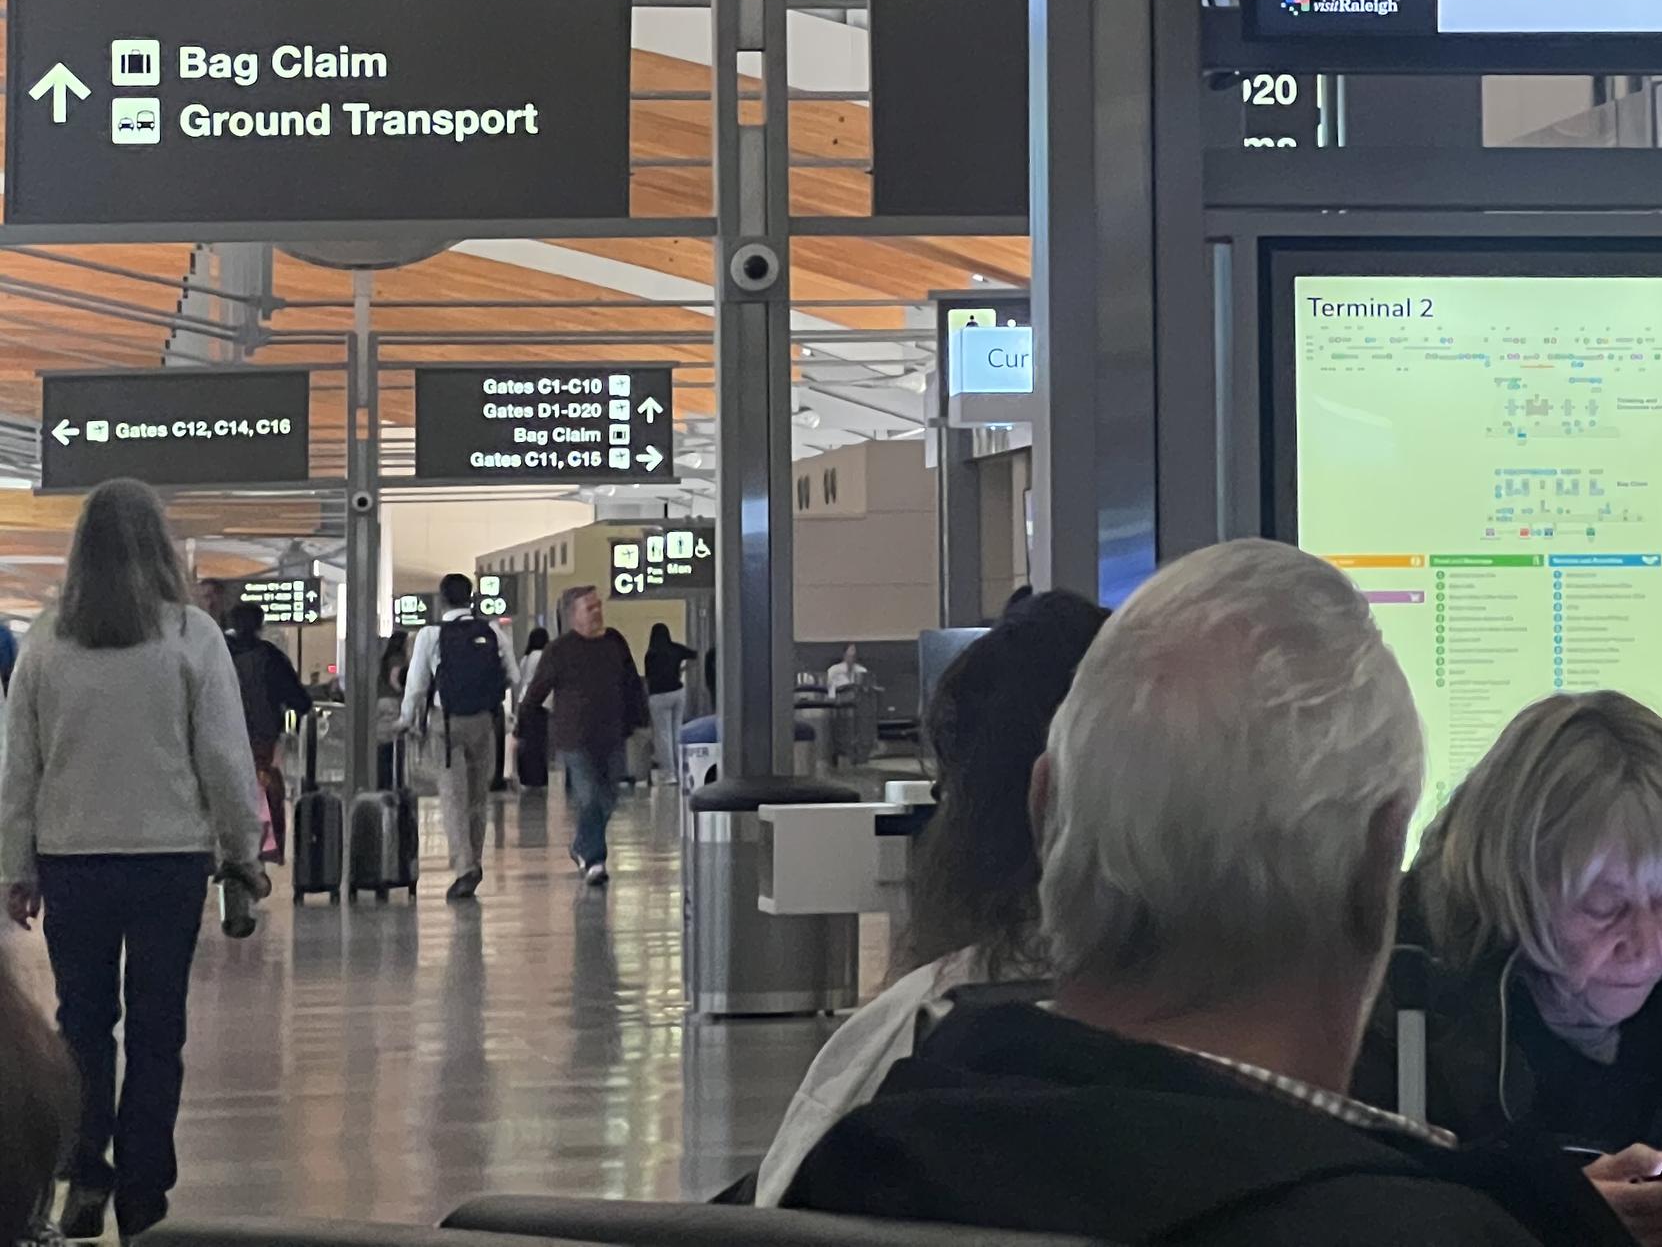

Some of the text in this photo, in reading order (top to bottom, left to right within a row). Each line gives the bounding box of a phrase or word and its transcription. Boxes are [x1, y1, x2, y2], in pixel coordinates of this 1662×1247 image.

[179, 45, 387, 85] Bag Claim
[179, 102, 539, 142] Ground Transport
[1306, 296, 1434, 319] Terminal 2
[988, 348, 1029, 368] Cur
[482, 377, 603, 395] Gates C1-C10
[482, 402, 603, 419] Gates D1-D20
[115, 418, 291, 439] Gates C12, C14, C16
[513, 426, 602, 446] Bag Claim
[470, 450, 602, 470] Gates C11, C15
[614, 573, 644, 594] C1
